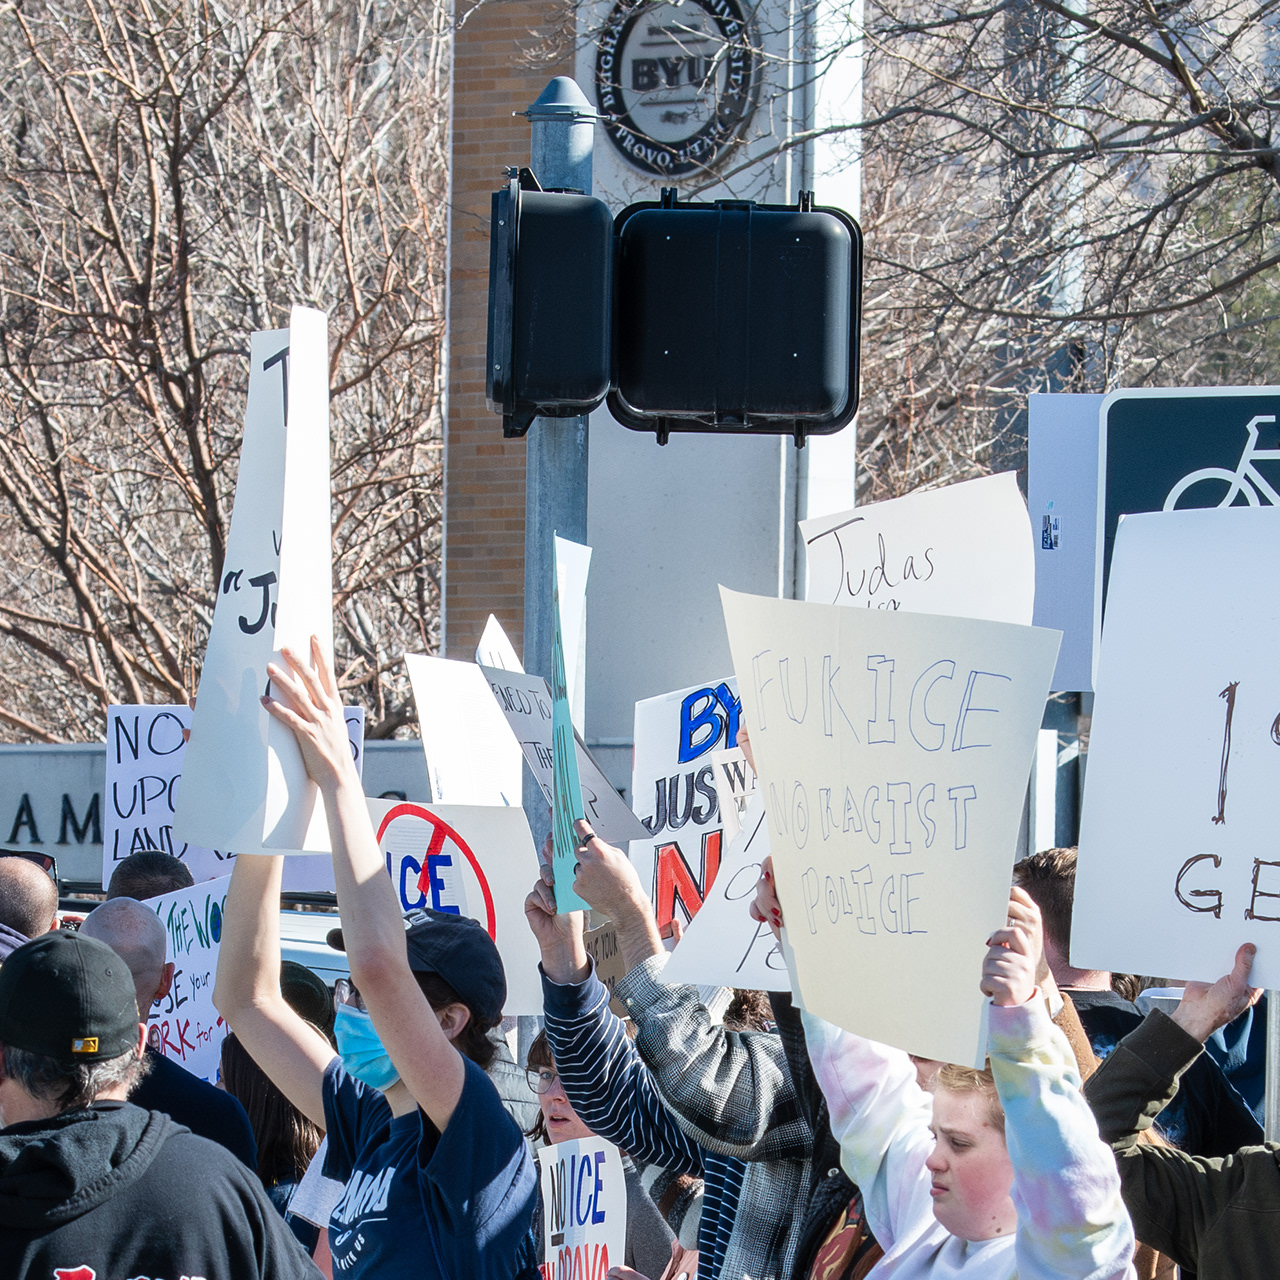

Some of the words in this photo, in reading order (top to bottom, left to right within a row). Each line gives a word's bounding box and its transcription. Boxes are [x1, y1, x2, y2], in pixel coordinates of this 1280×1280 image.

[631, 55, 720, 91] BYU
[807, 516, 935, 604] Judas
[867, 654, 1012, 752] ICE
[641, 763, 723, 836] JUS
[769, 780, 810, 849] NO
[167, 901, 194, 958] THE
[802, 864, 928, 935] POLICE
[148, 1018, 196, 1061] ORK
[549, 1157, 566, 1232] NO
[570, 1150, 606, 1228] ICE
